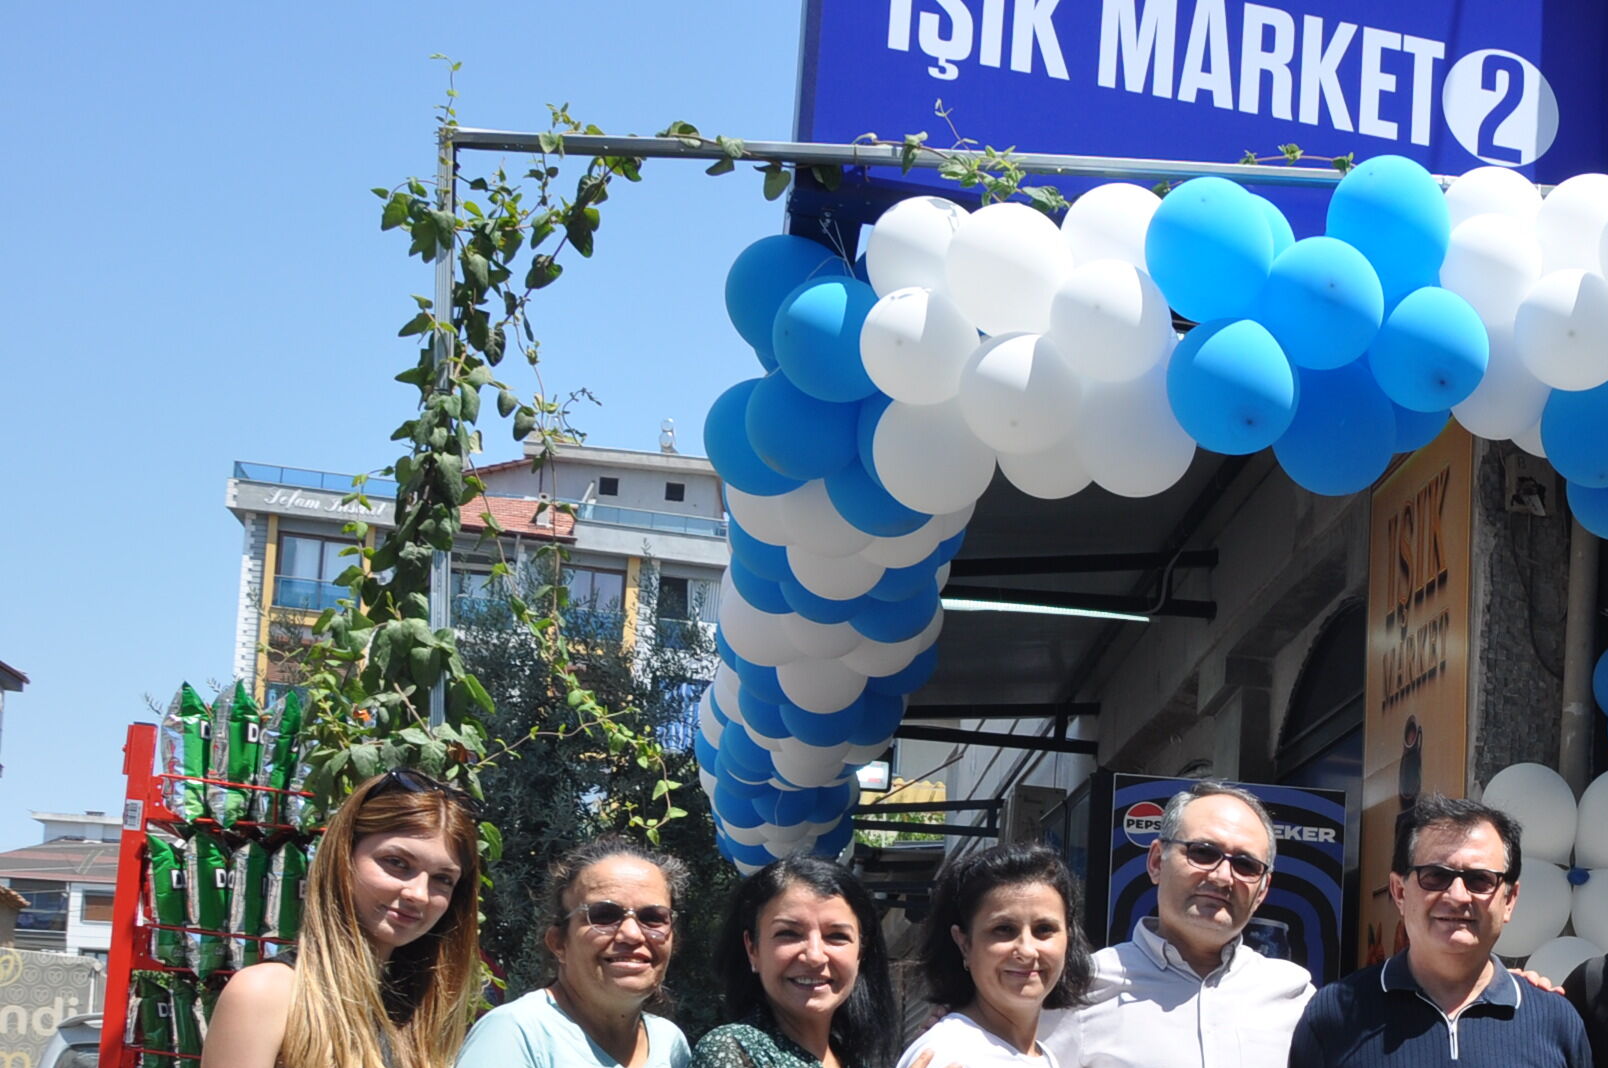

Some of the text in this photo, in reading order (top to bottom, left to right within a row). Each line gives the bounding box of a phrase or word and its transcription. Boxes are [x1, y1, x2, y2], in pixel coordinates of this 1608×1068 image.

[1097, 0, 1446, 147] MARKET
[1382, 608, 1449, 707] MARKET
[1126, 818, 1336, 844] PEPS EKER
